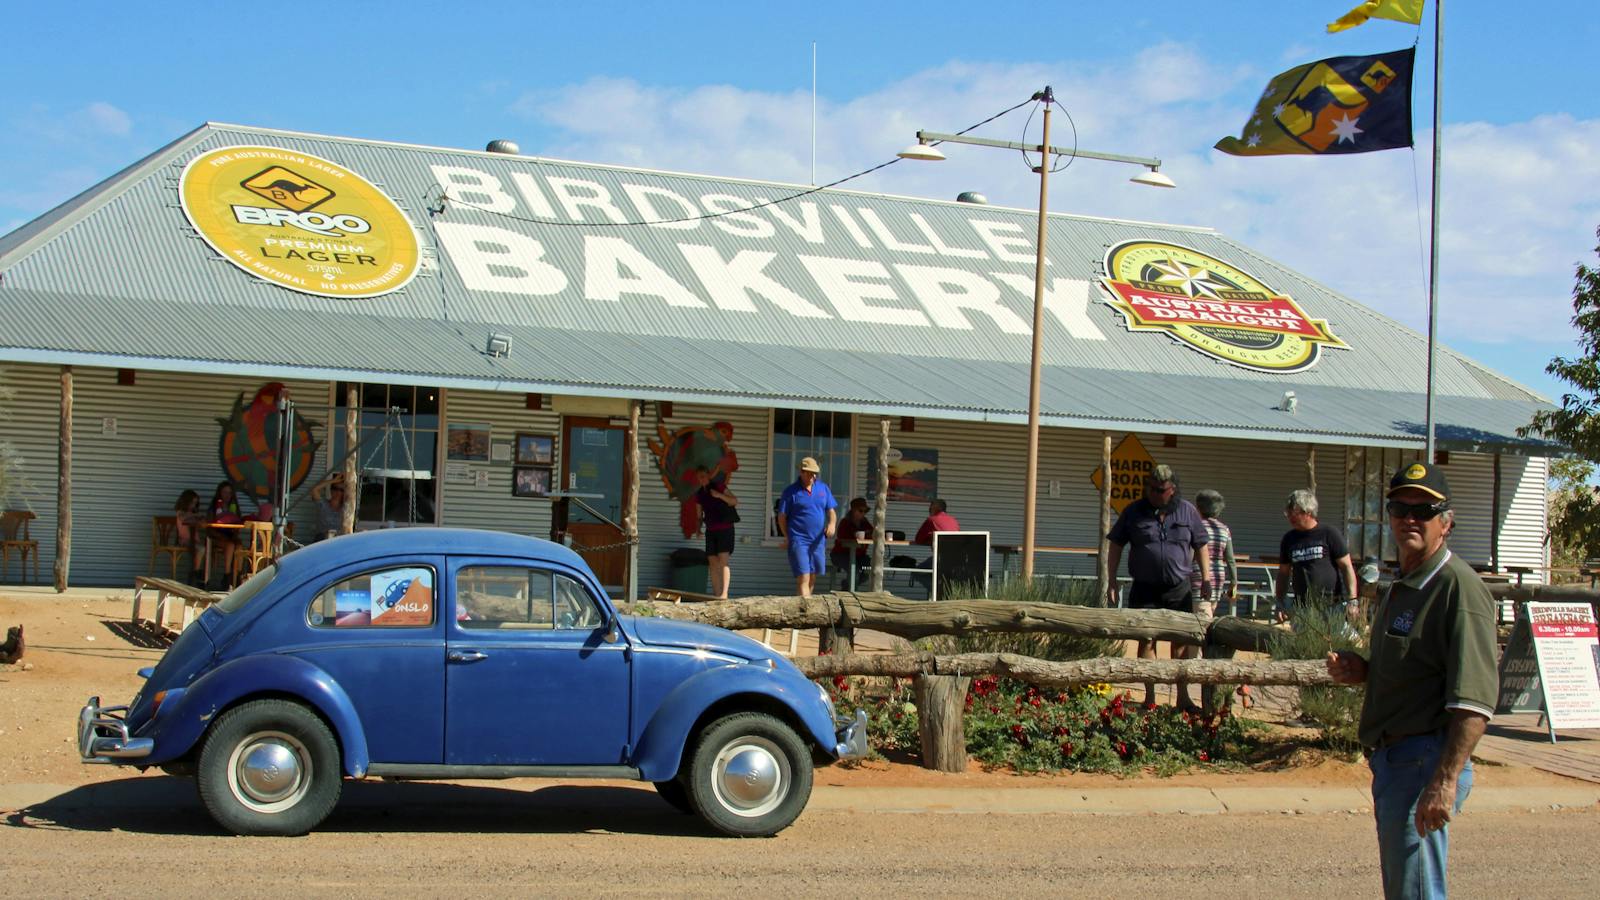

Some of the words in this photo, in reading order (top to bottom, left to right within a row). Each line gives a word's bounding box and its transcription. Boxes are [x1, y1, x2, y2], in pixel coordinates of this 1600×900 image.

[210, 154, 234, 167] PURE
[235, 151, 305, 164] AUSTRALIAN
[309, 160, 345, 178] LAGER
[271, 190, 287, 200] B
[230, 204, 372, 238] BROO
[430, 164, 1054, 266] BIRDSVILLE
[260, 246, 378, 266] LAGER
[264, 238, 365, 254] PREMIUM
[233, 249, 252, 262] ALL
[254, 260, 308, 286] NATURAL
[320, 282, 338, 290] NO
[341, 262, 405, 290] PRESERVATIVES
[1202, 260, 1250, 285] STYLE
[432, 220, 1108, 341] BAKERY
[1138, 282, 1182, 294] PROUD
[1223, 292, 1264, 300] NATION
[1130, 294, 1303, 319] AUSTRALIA
[1148, 306, 1302, 330] DRAUGHT
[1190, 333, 1268, 360] DRAUGHT
[1110, 460, 1152, 472] HARD
[1532, 613, 1591, 624] BREAKFAST
